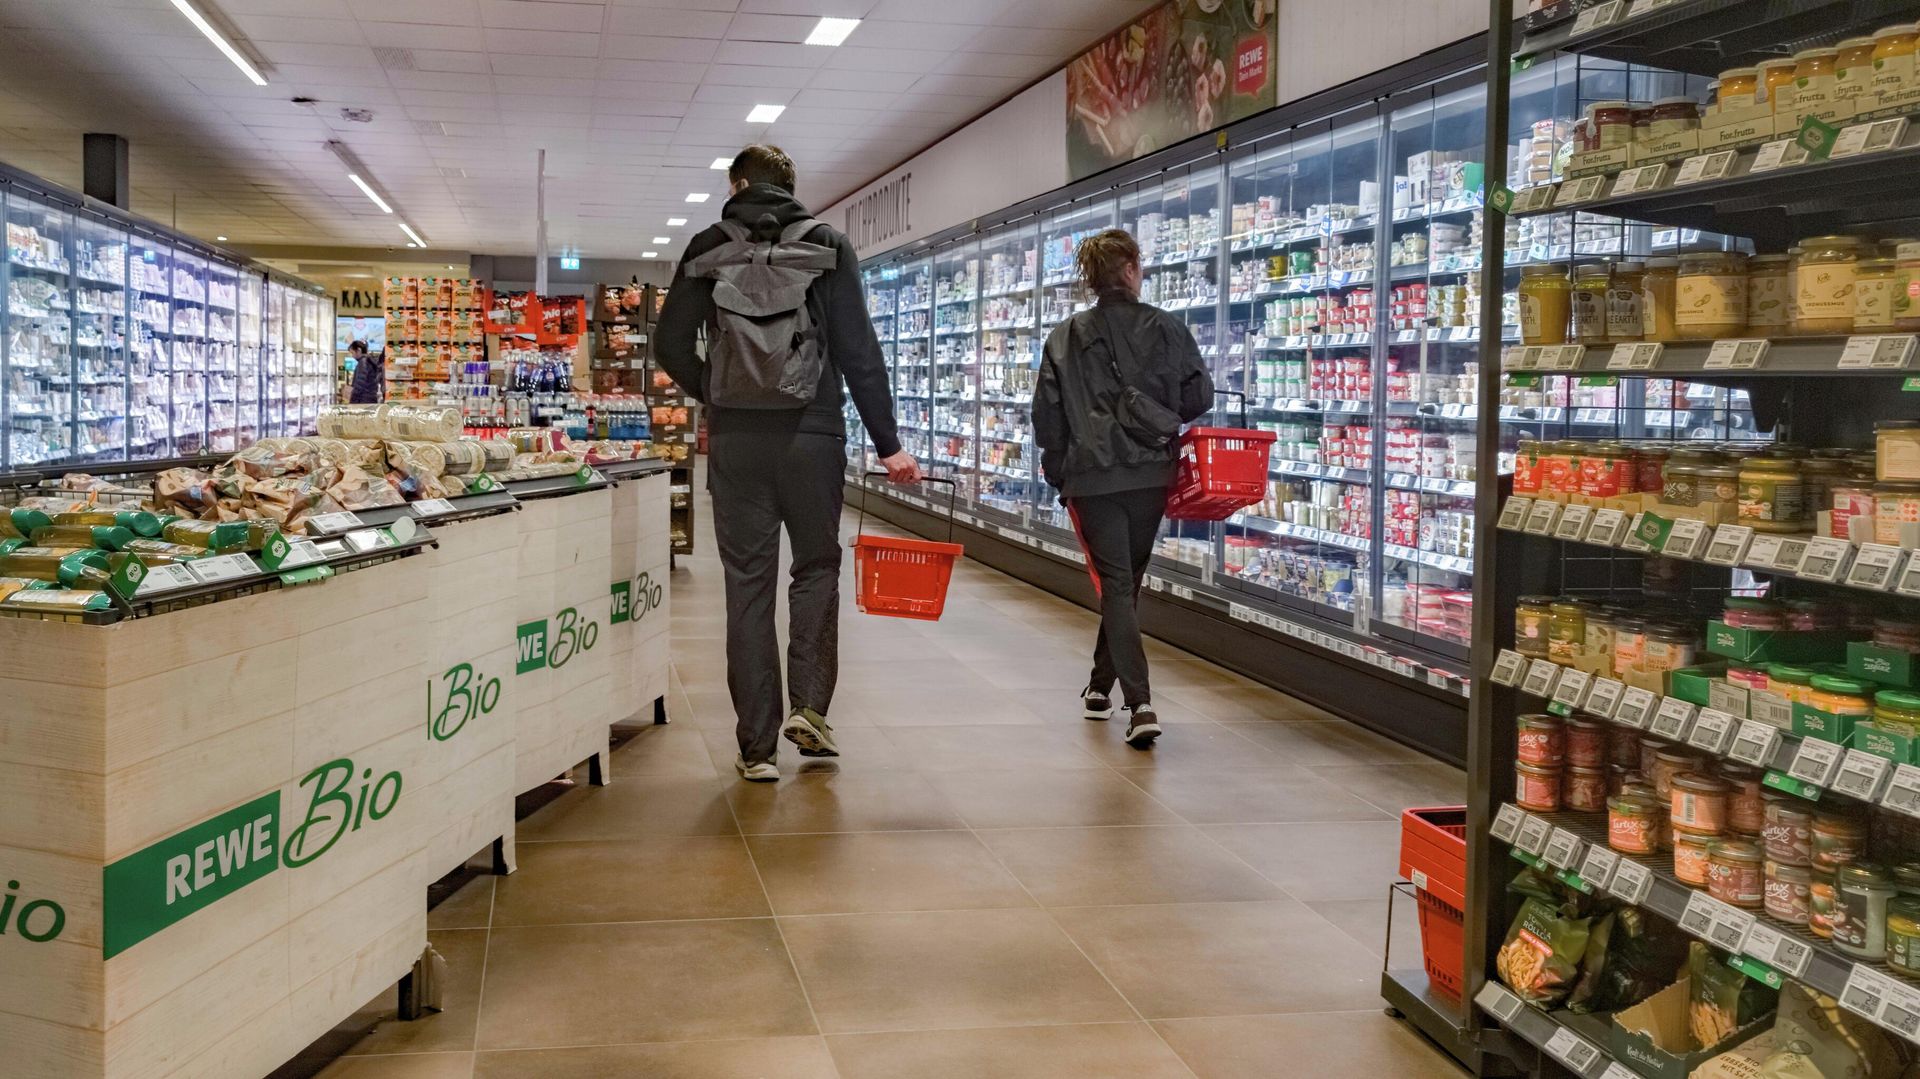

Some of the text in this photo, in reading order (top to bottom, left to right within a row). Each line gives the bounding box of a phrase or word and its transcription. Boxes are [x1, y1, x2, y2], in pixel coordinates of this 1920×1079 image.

[1239, 45, 1263, 69] REWE
[1720, 128, 1756, 142] Fior.frutta
[1583, 154, 1611, 166] Fior.frutta
[1396, 181, 1408, 193] ja!
[611, 571, 662, 622] WE Bio
[516, 607, 598, 669] WE Bio
[432, 662, 501, 742] Bio
[1519, 734, 1538, 748] artex
[166, 758, 402, 906] REWE Bio
[0, 879, 66, 943] io
[1721, 1063, 1735, 1074] MIT
[1744, 1056, 1760, 1067] BIO
